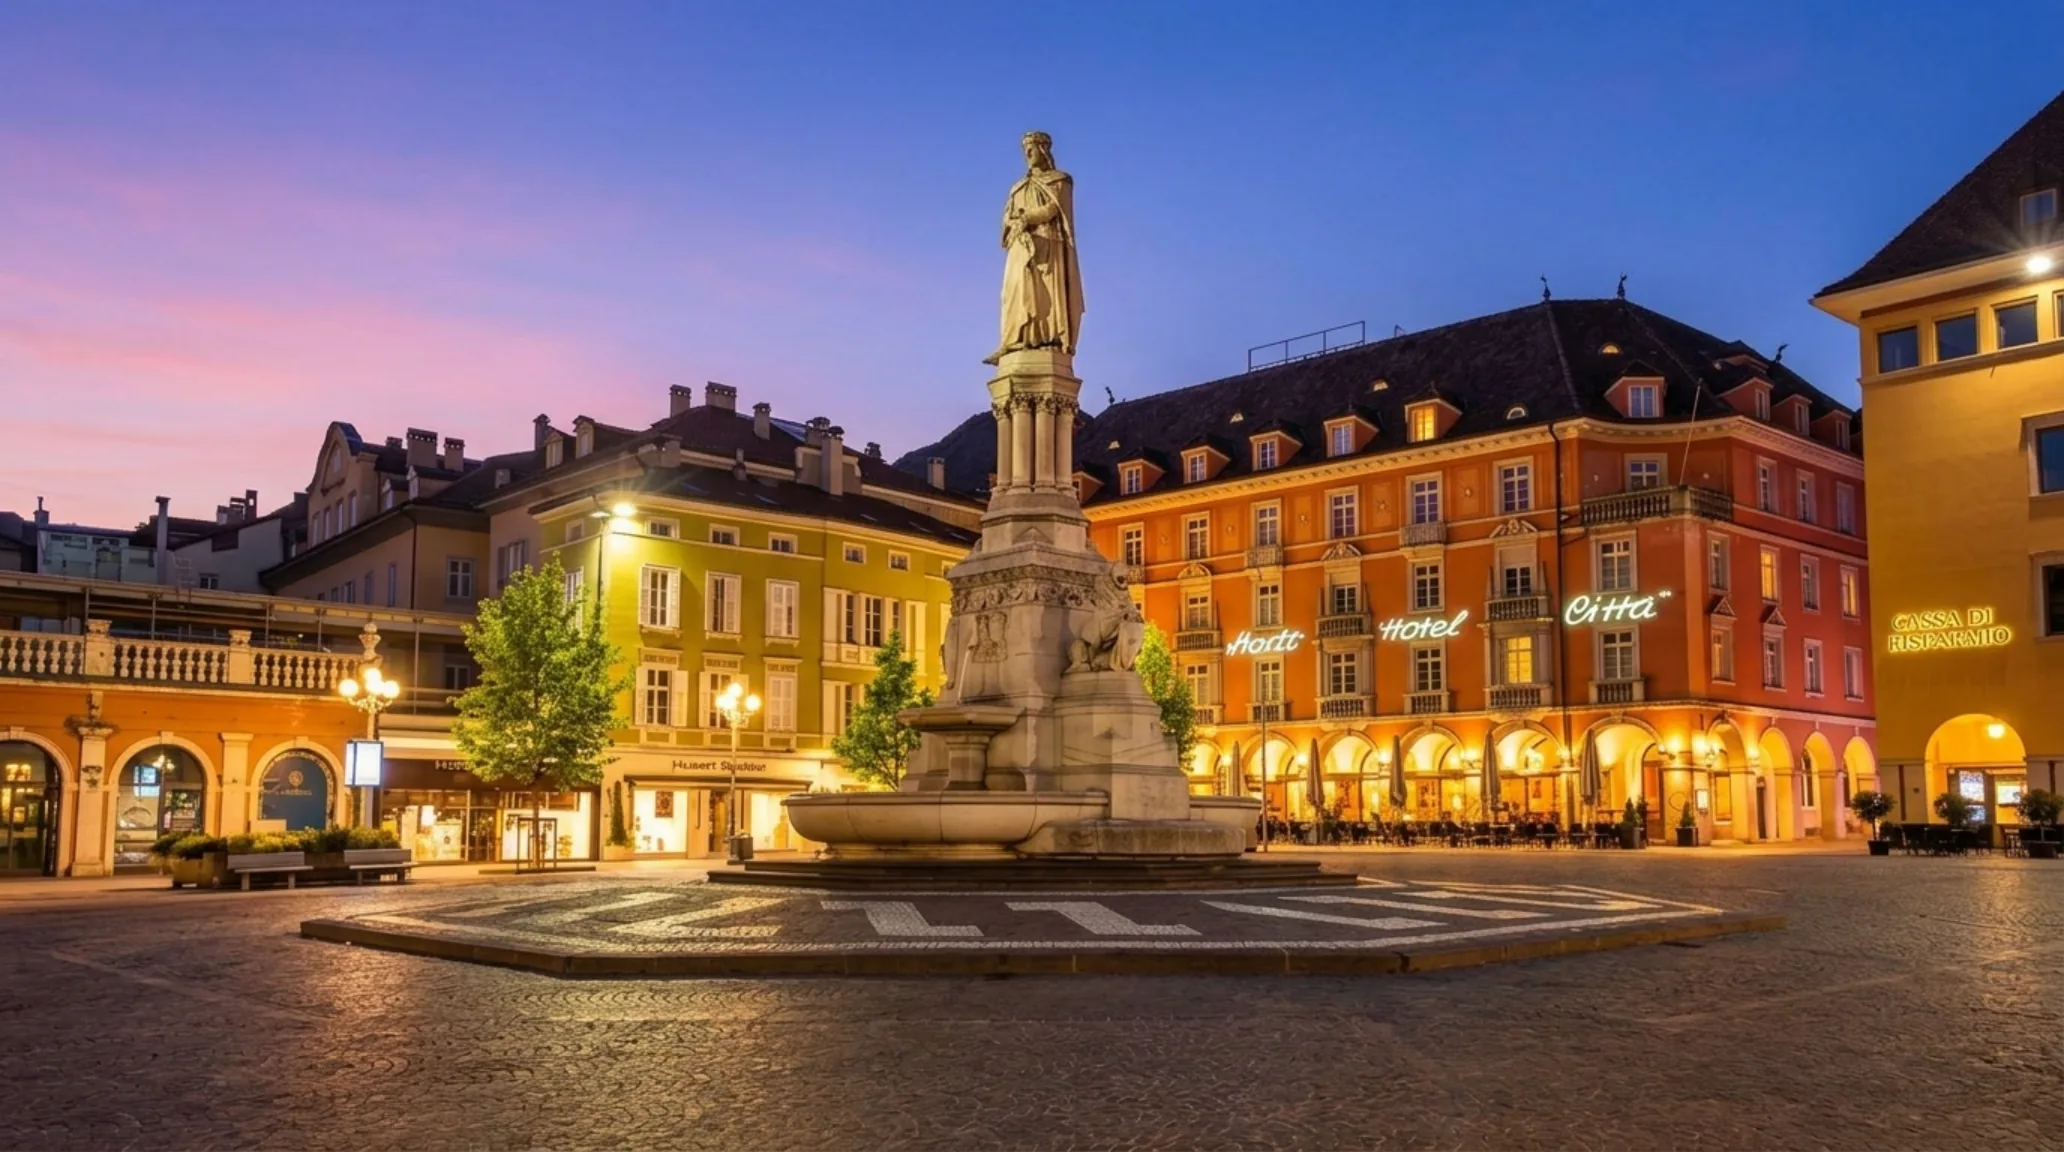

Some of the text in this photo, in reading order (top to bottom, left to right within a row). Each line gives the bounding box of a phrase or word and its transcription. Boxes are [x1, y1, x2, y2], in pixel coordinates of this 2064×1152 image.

[1379, 609, 1469, 640] Hotel
[1891, 607, 1993, 632] CASSA DI
[1888, 626, 2012, 653] RISPARMIO
